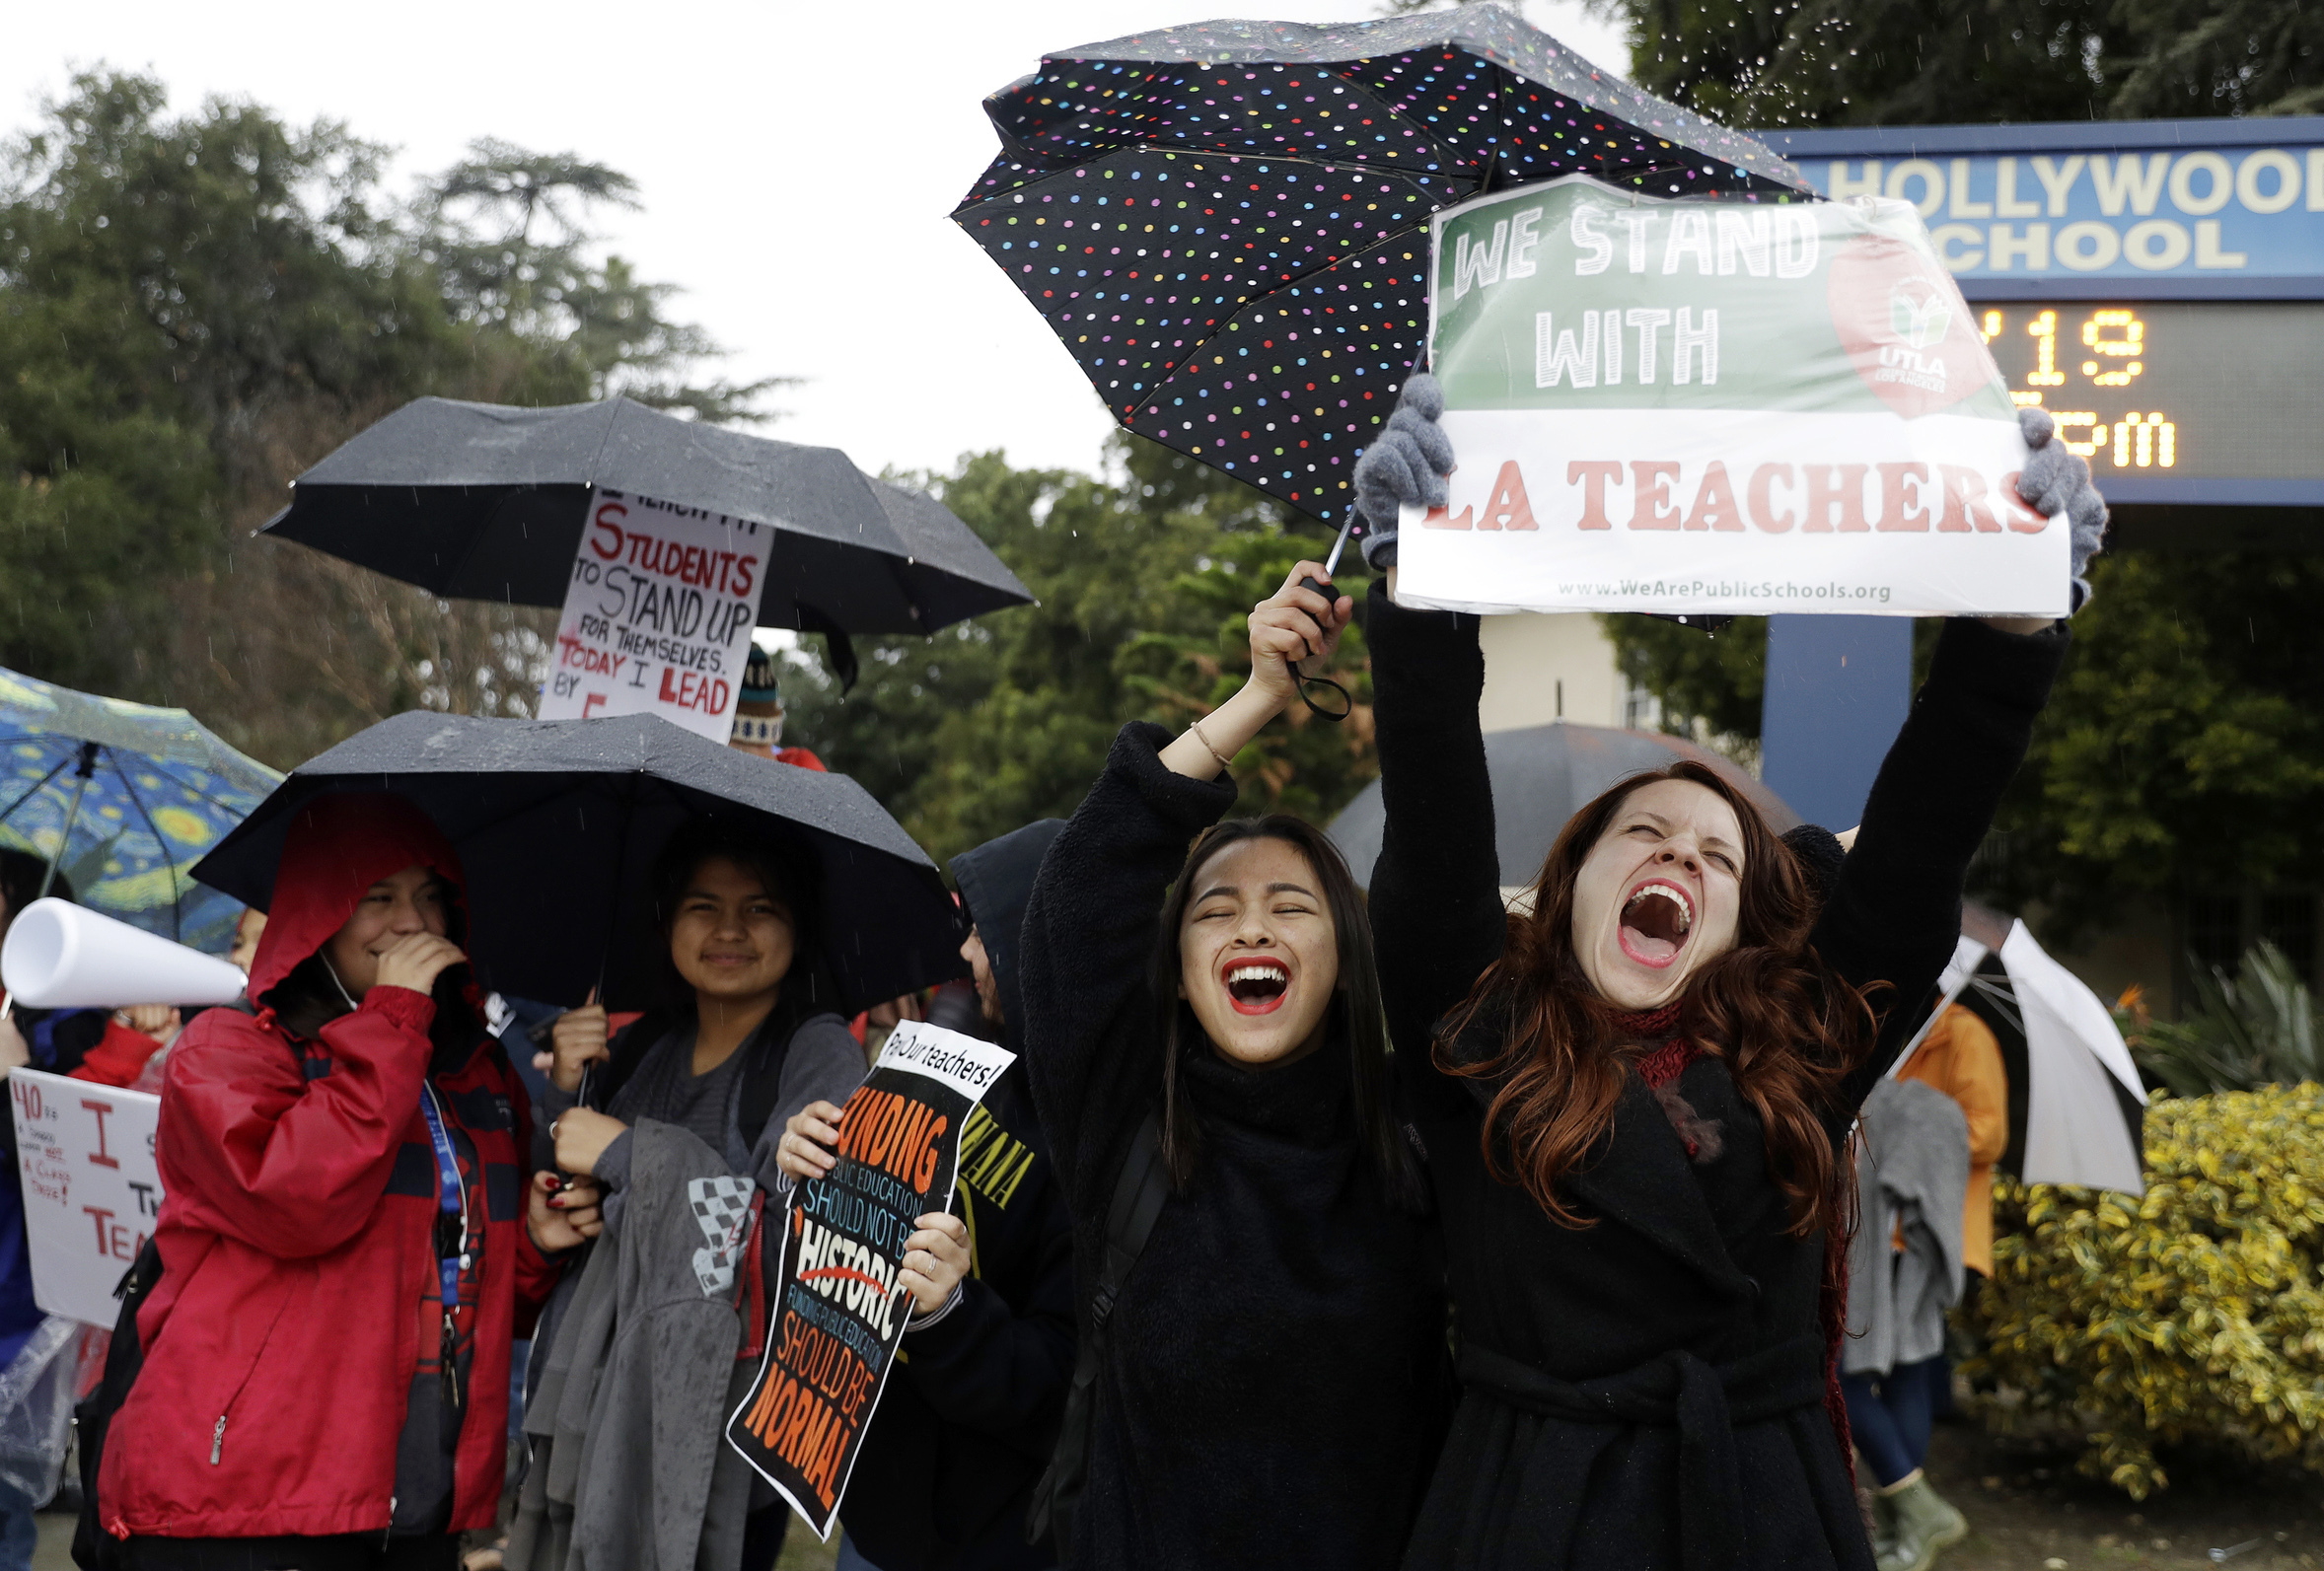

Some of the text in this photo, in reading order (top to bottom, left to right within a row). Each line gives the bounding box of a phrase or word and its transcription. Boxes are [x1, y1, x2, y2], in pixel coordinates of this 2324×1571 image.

[1829, 148, 2324, 220] HOLLYWOO
[1454, 204, 1819, 301] WE STAND
[1930, 219, 2248, 272] CHOOL
[1535, 306, 1718, 390] WITH
[1878, 346, 1946, 380] UTLA
[1898, 375, 1946, 393] ANGELES
[1421, 460, 2049, 535] LA TEACHERS
[591, 502, 759, 598] STUDENTS
[574, 557, 752, 648] TO STAND UP
[1558, 579, 1892, 603] www.WeArePublicSchools.org
[558, 635, 626, 680] TODAY
[628, 660, 650, 688] I
[659, 667, 730, 716] LEAD
[579, 613, 727, 675] FOR THEMSELVES.
[553, 672, 580, 700] BY
[899, 1034, 928, 1061] Our
[921, 1043, 1002, 1088] teachers!
[13, 1081, 41, 1120] 40
[82, 1098, 120, 1171] I
[803, 1178, 915, 1260] SHOULD NOT B
[856, 1167, 923, 1220] EDUCATION
[796, 1218, 908, 1341] HISTORIC
[786, 1283, 885, 1374] FUNDING PUBLIC EDUCATION
[776, 1310, 875, 1428] SHOULD BE
[744, 1361, 851, 1512] NORMAL
